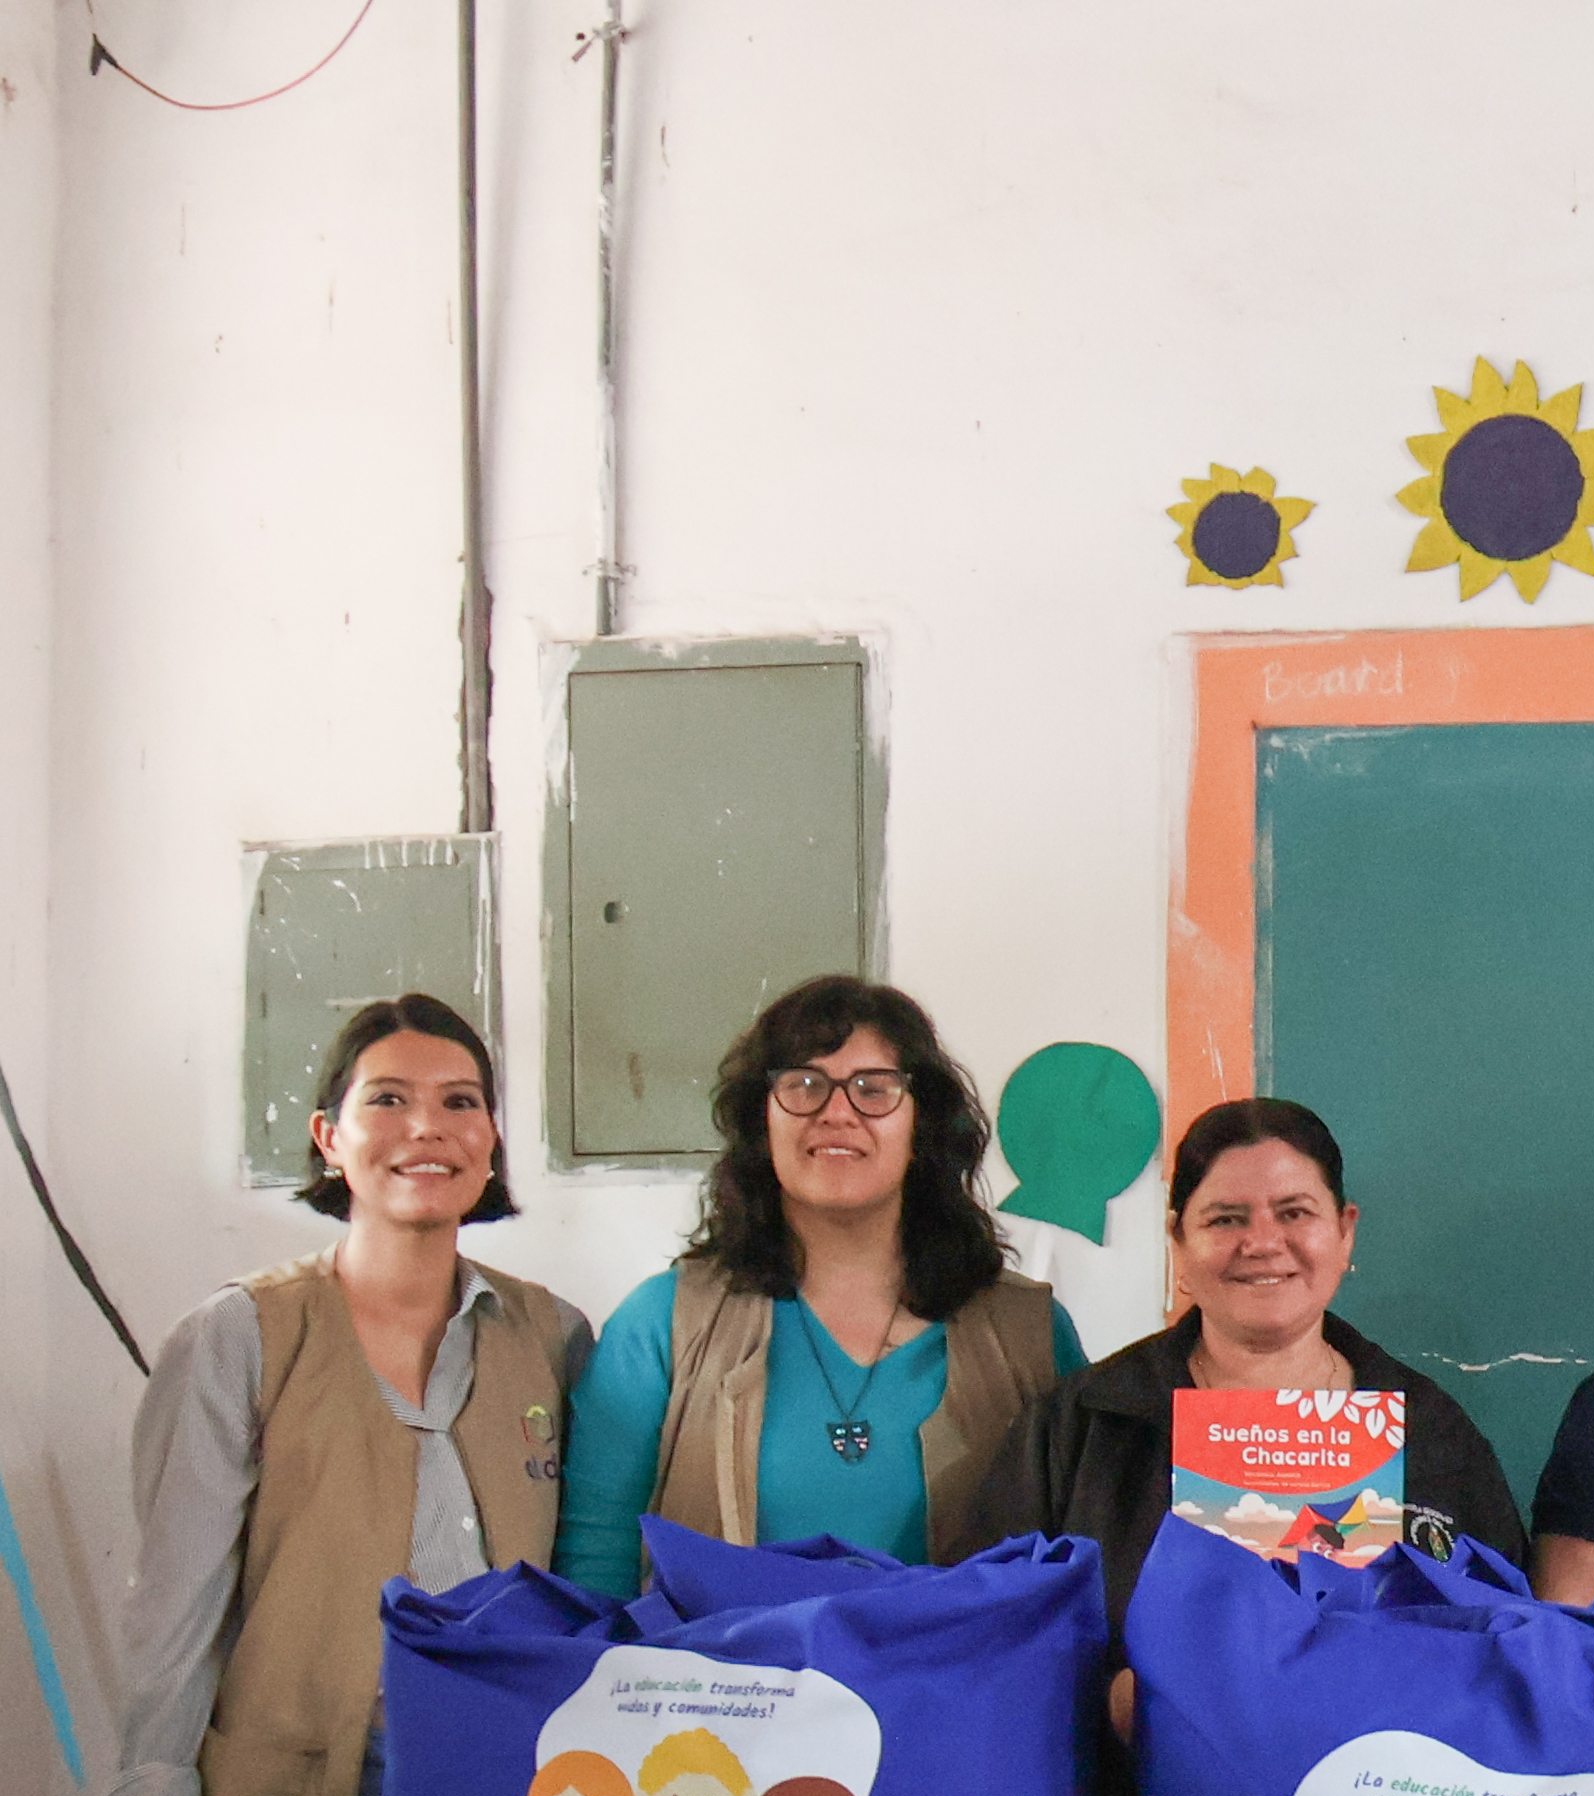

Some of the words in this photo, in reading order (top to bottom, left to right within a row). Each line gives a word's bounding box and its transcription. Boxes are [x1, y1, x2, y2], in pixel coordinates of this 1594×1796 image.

[1208, 1423, 1289, 1443] Sueños
[1297, 1429, 1324, 1444] en
[1331, 1427, 1350, 1445] la
[1242, 1447, 1350, 1467] Chacarita
[710, 1682, 795, 1698] transforma
[669, 1703, 775, 1718] comunidades!
[1354, 1771, 1383, 1789] ¡La
